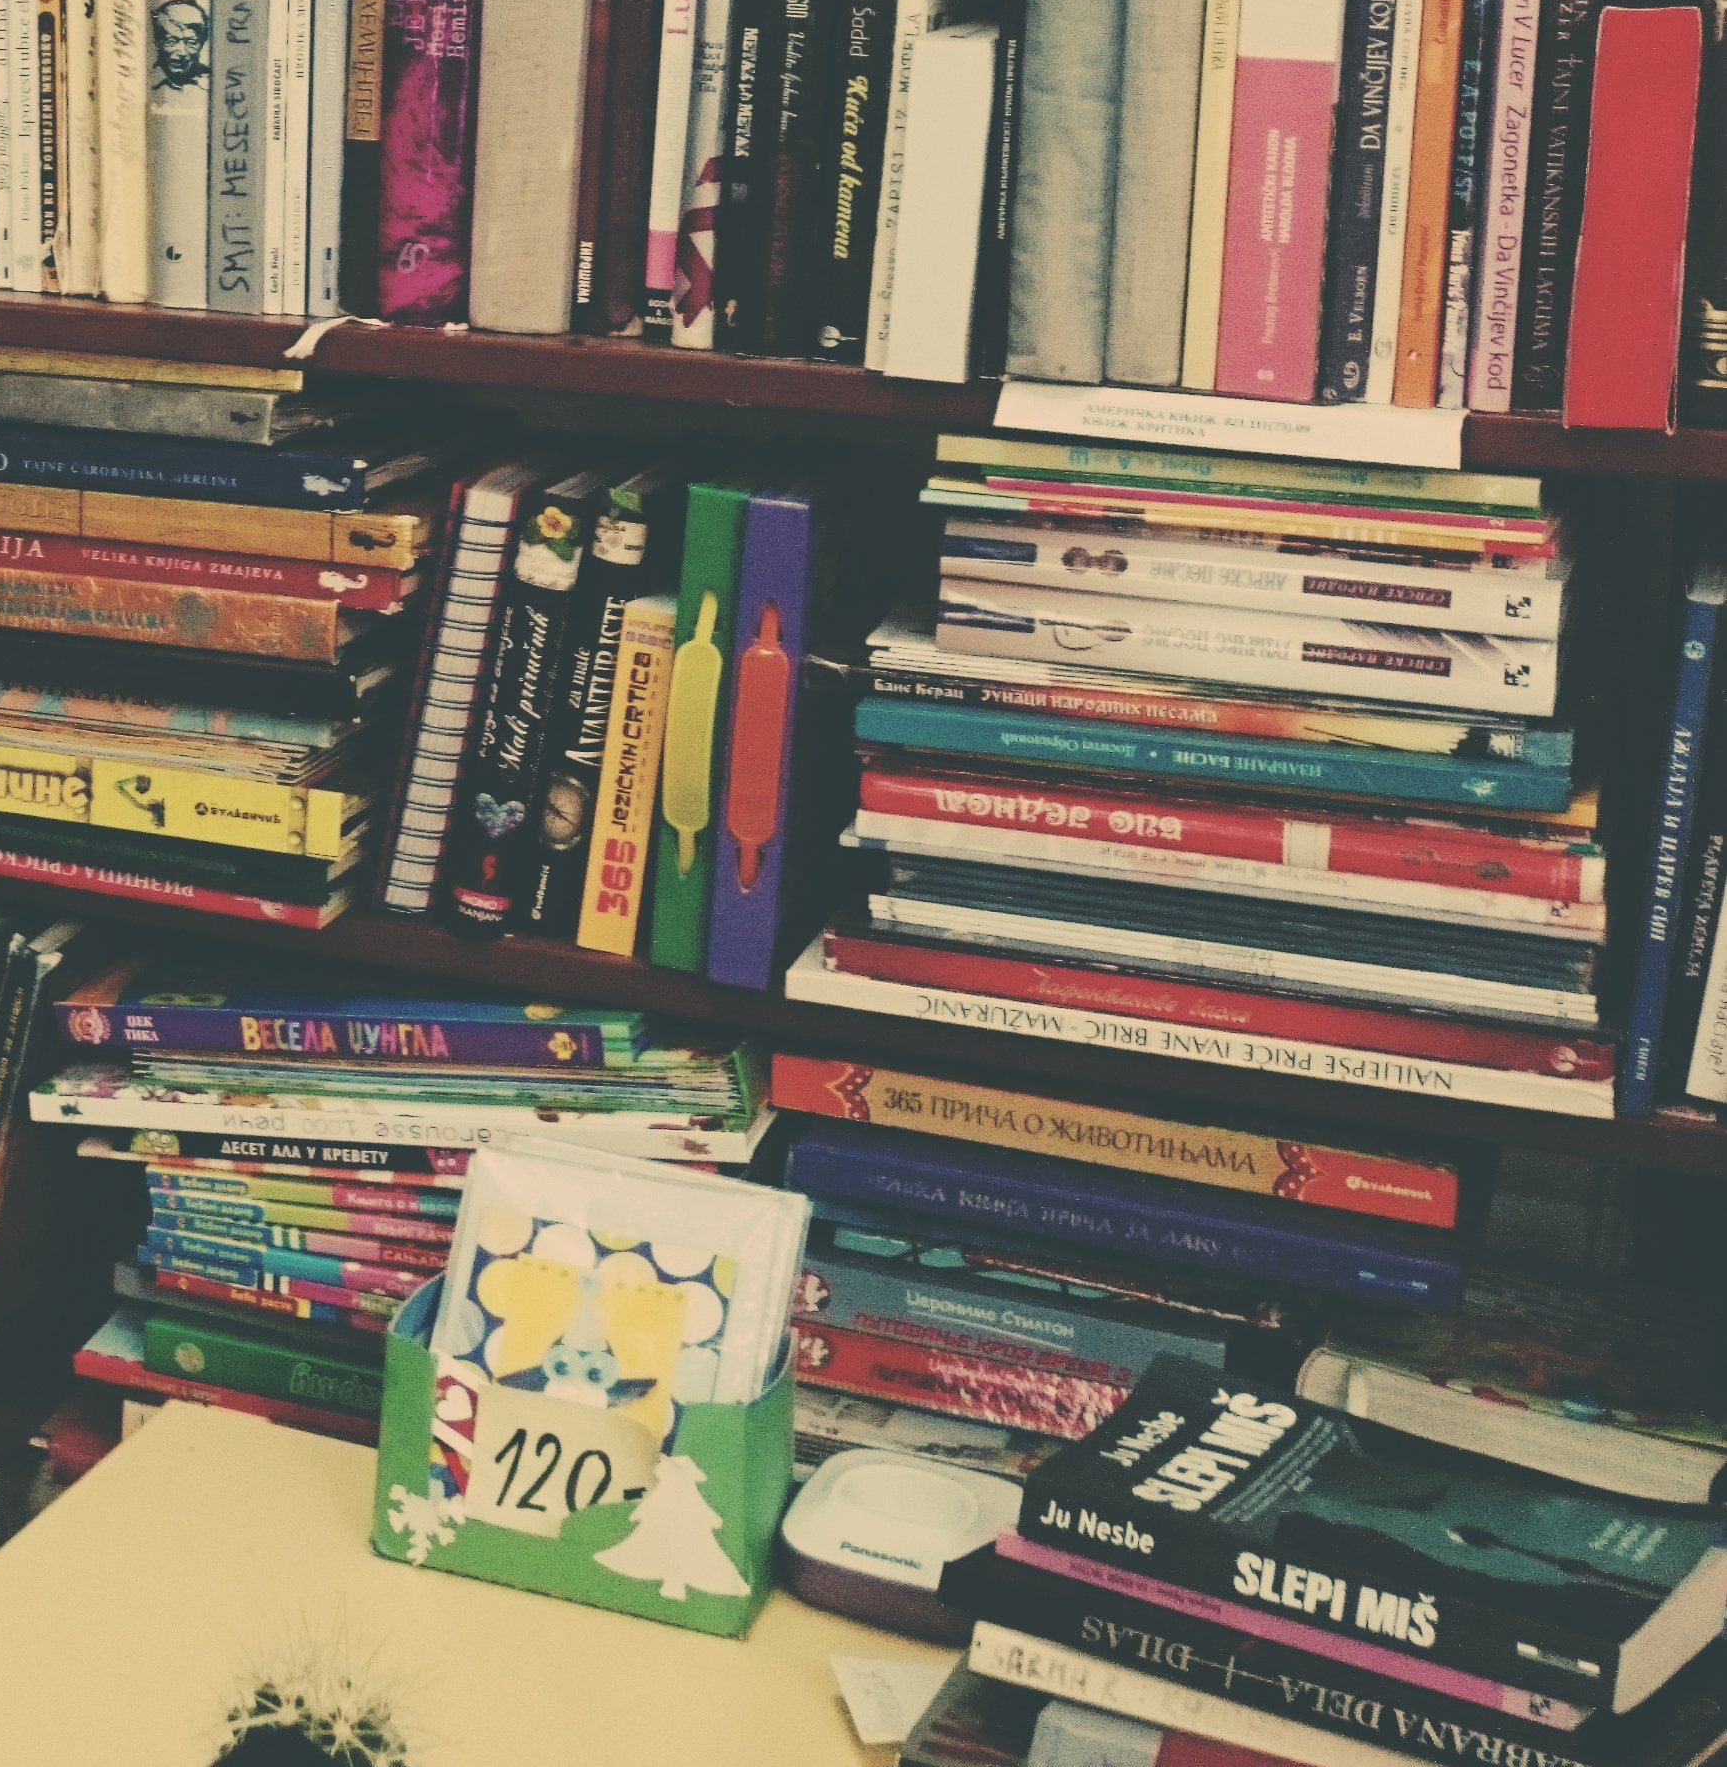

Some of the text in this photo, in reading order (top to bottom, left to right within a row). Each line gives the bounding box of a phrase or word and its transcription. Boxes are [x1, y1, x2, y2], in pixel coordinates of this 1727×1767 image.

[847, 5, 874, 58] Šadid
[1358, 36, 1392, 118] VINČIJEV
[1359, 120, 1381, 150] DA
[830, 74, 873, 260] Kuća od kamena
[1135, 422, 1204, 436] КРИТИКА
[80, 547, 138, 565] VELIKA
[143, 555, 201, 574] KNJIGA
[207, 562, 283, 582] ZMAJEVA
[912, 994, 1454, 1094] NAJLJEPŠE PRIČE IVANE BRLIĆ MAŽURANIĆ
[220, 1140, 388, 1165] ДЕСЕТ АЛА У КРЕВЕТУ
[882, 1086, 1260, 1175] 365 ПРИЧА О ЖИВОТИЊАМА
[839, 1540, 923, 1571] Panasonic
[1038, 1496, 1159, 1558] Ju Nesbe
[1228, 1549, 1447, 1649] SLEPI MIŠ
